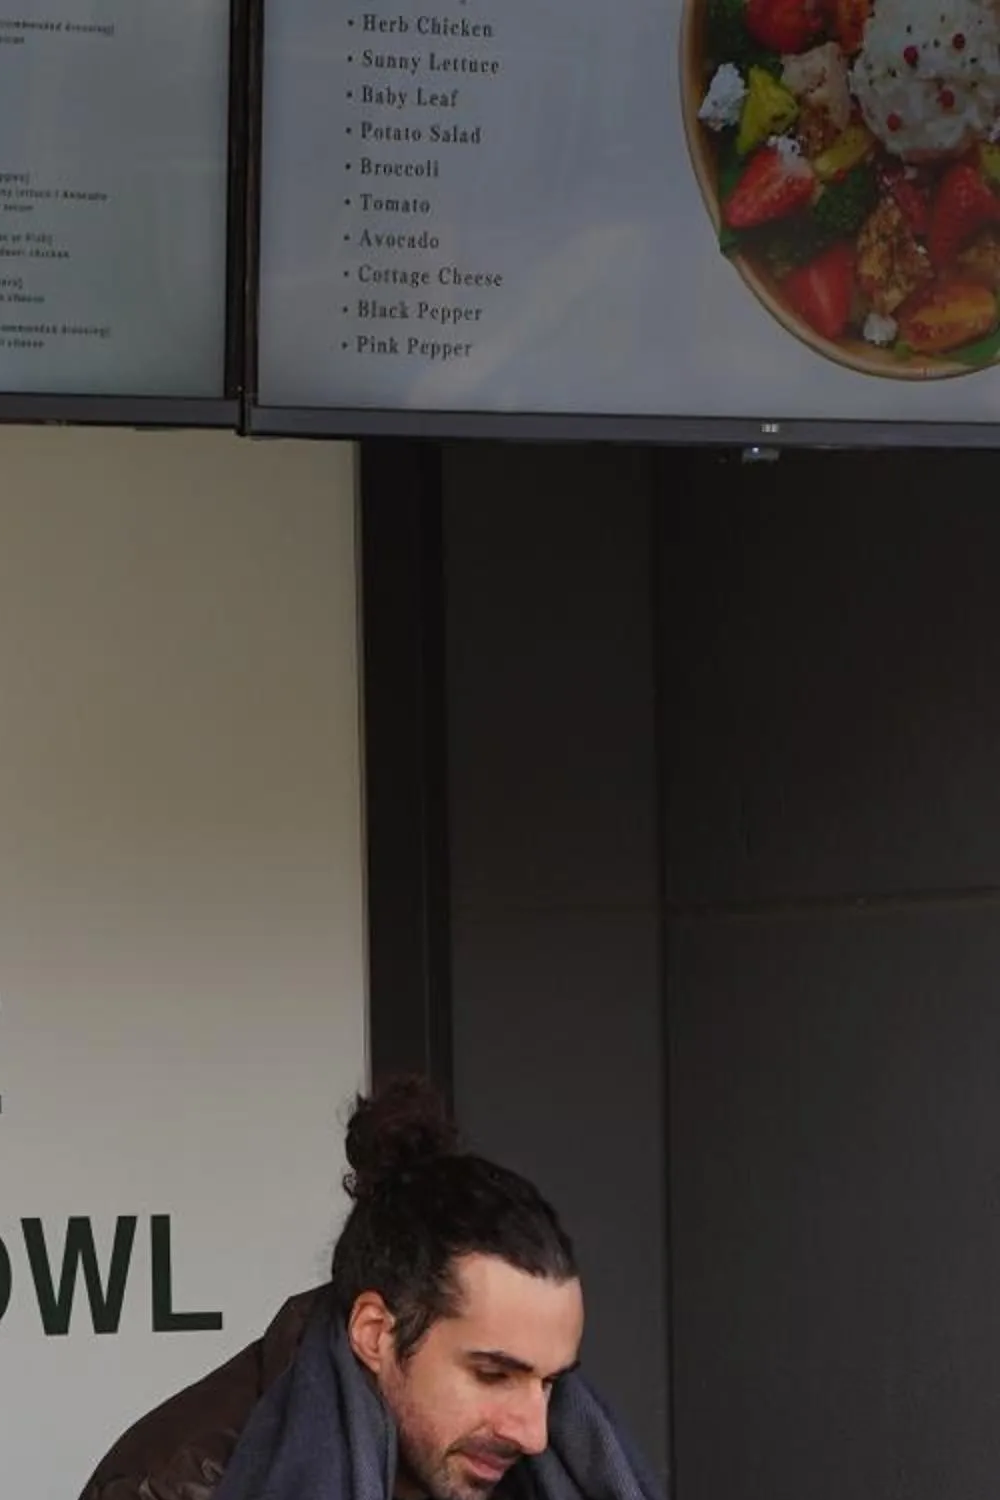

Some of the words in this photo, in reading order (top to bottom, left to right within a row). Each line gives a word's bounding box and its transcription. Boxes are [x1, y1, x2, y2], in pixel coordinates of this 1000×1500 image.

[363, 14, 409, 33] Herb
[416, 15, 494, 37] Chicken
[362, 49, 421, 75] Sunny
[429, 52, 500, 74] Lettuce
[362, 85, 407, 109] Baby
[417, 87, 459, 107] Leaf
[361, 121, 422, 141] Potato
[430, 124, 482, 144] Salad
[360, 157, 440, 178] Broccoli
[360, 193, 431, 214] Tomato
[359, 228, 440, 250] Avocado
[358, 264, 430, 288] Cottage
[438, 267, 504, 287] Cheese
[358, 299, 409, 320] Black
[417, 301, 483, 325] Pepper
[357, 335, 399, 354] Pink
[407, 337, 472, 361] Pepper
